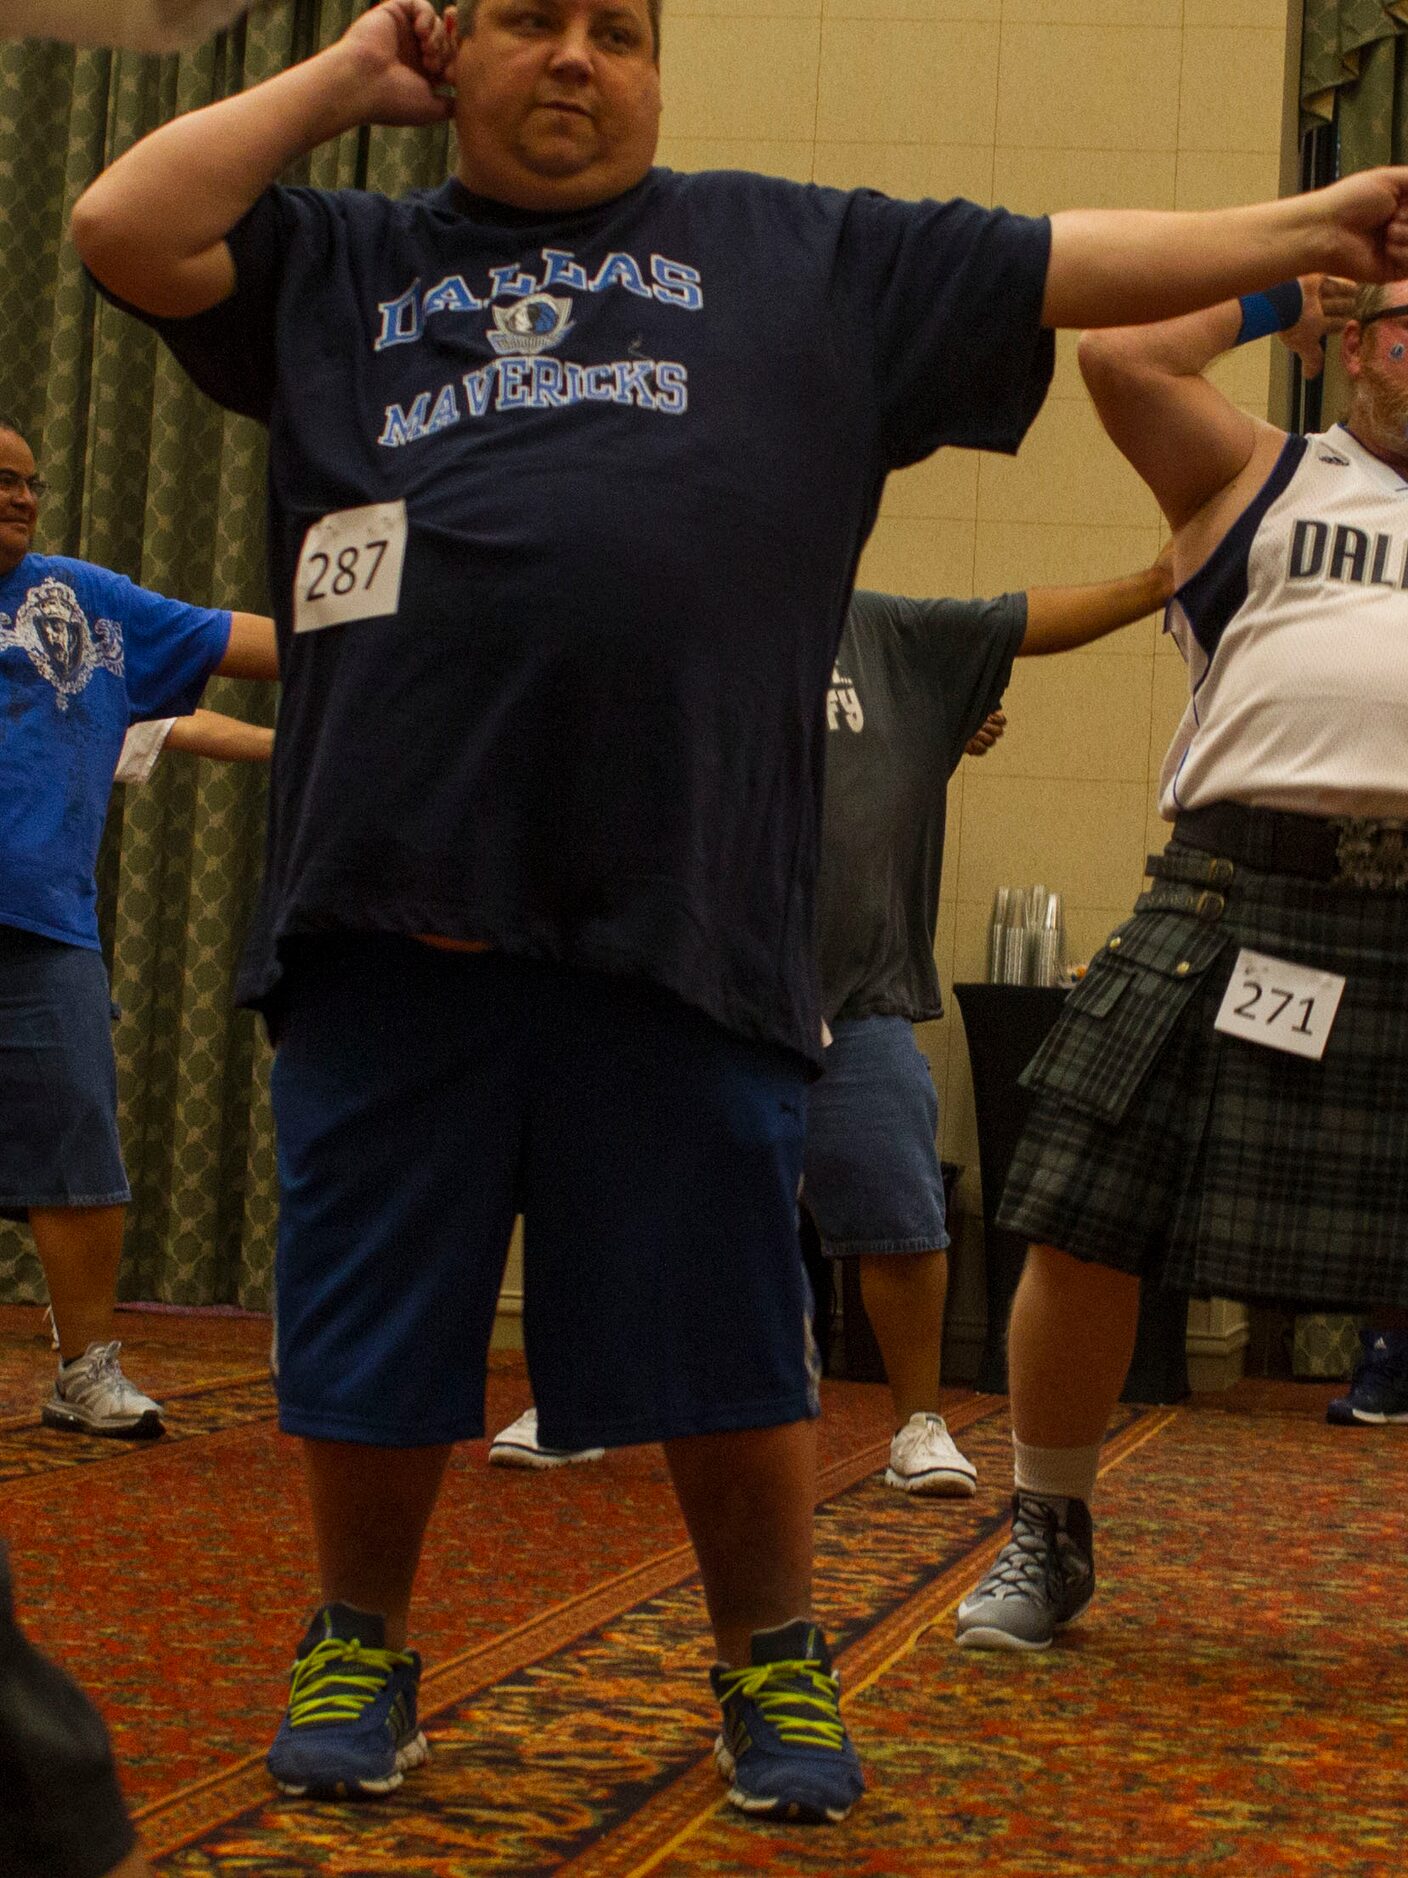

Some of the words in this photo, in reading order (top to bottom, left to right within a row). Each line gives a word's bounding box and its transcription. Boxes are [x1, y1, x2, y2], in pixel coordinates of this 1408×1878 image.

[374, 248, 704, 351] DALLAS
[377, 355, 689, 448] MAVERICKS
[306, 540, 388, 602] 287
[1234, 981, 1315, 1036] 271
